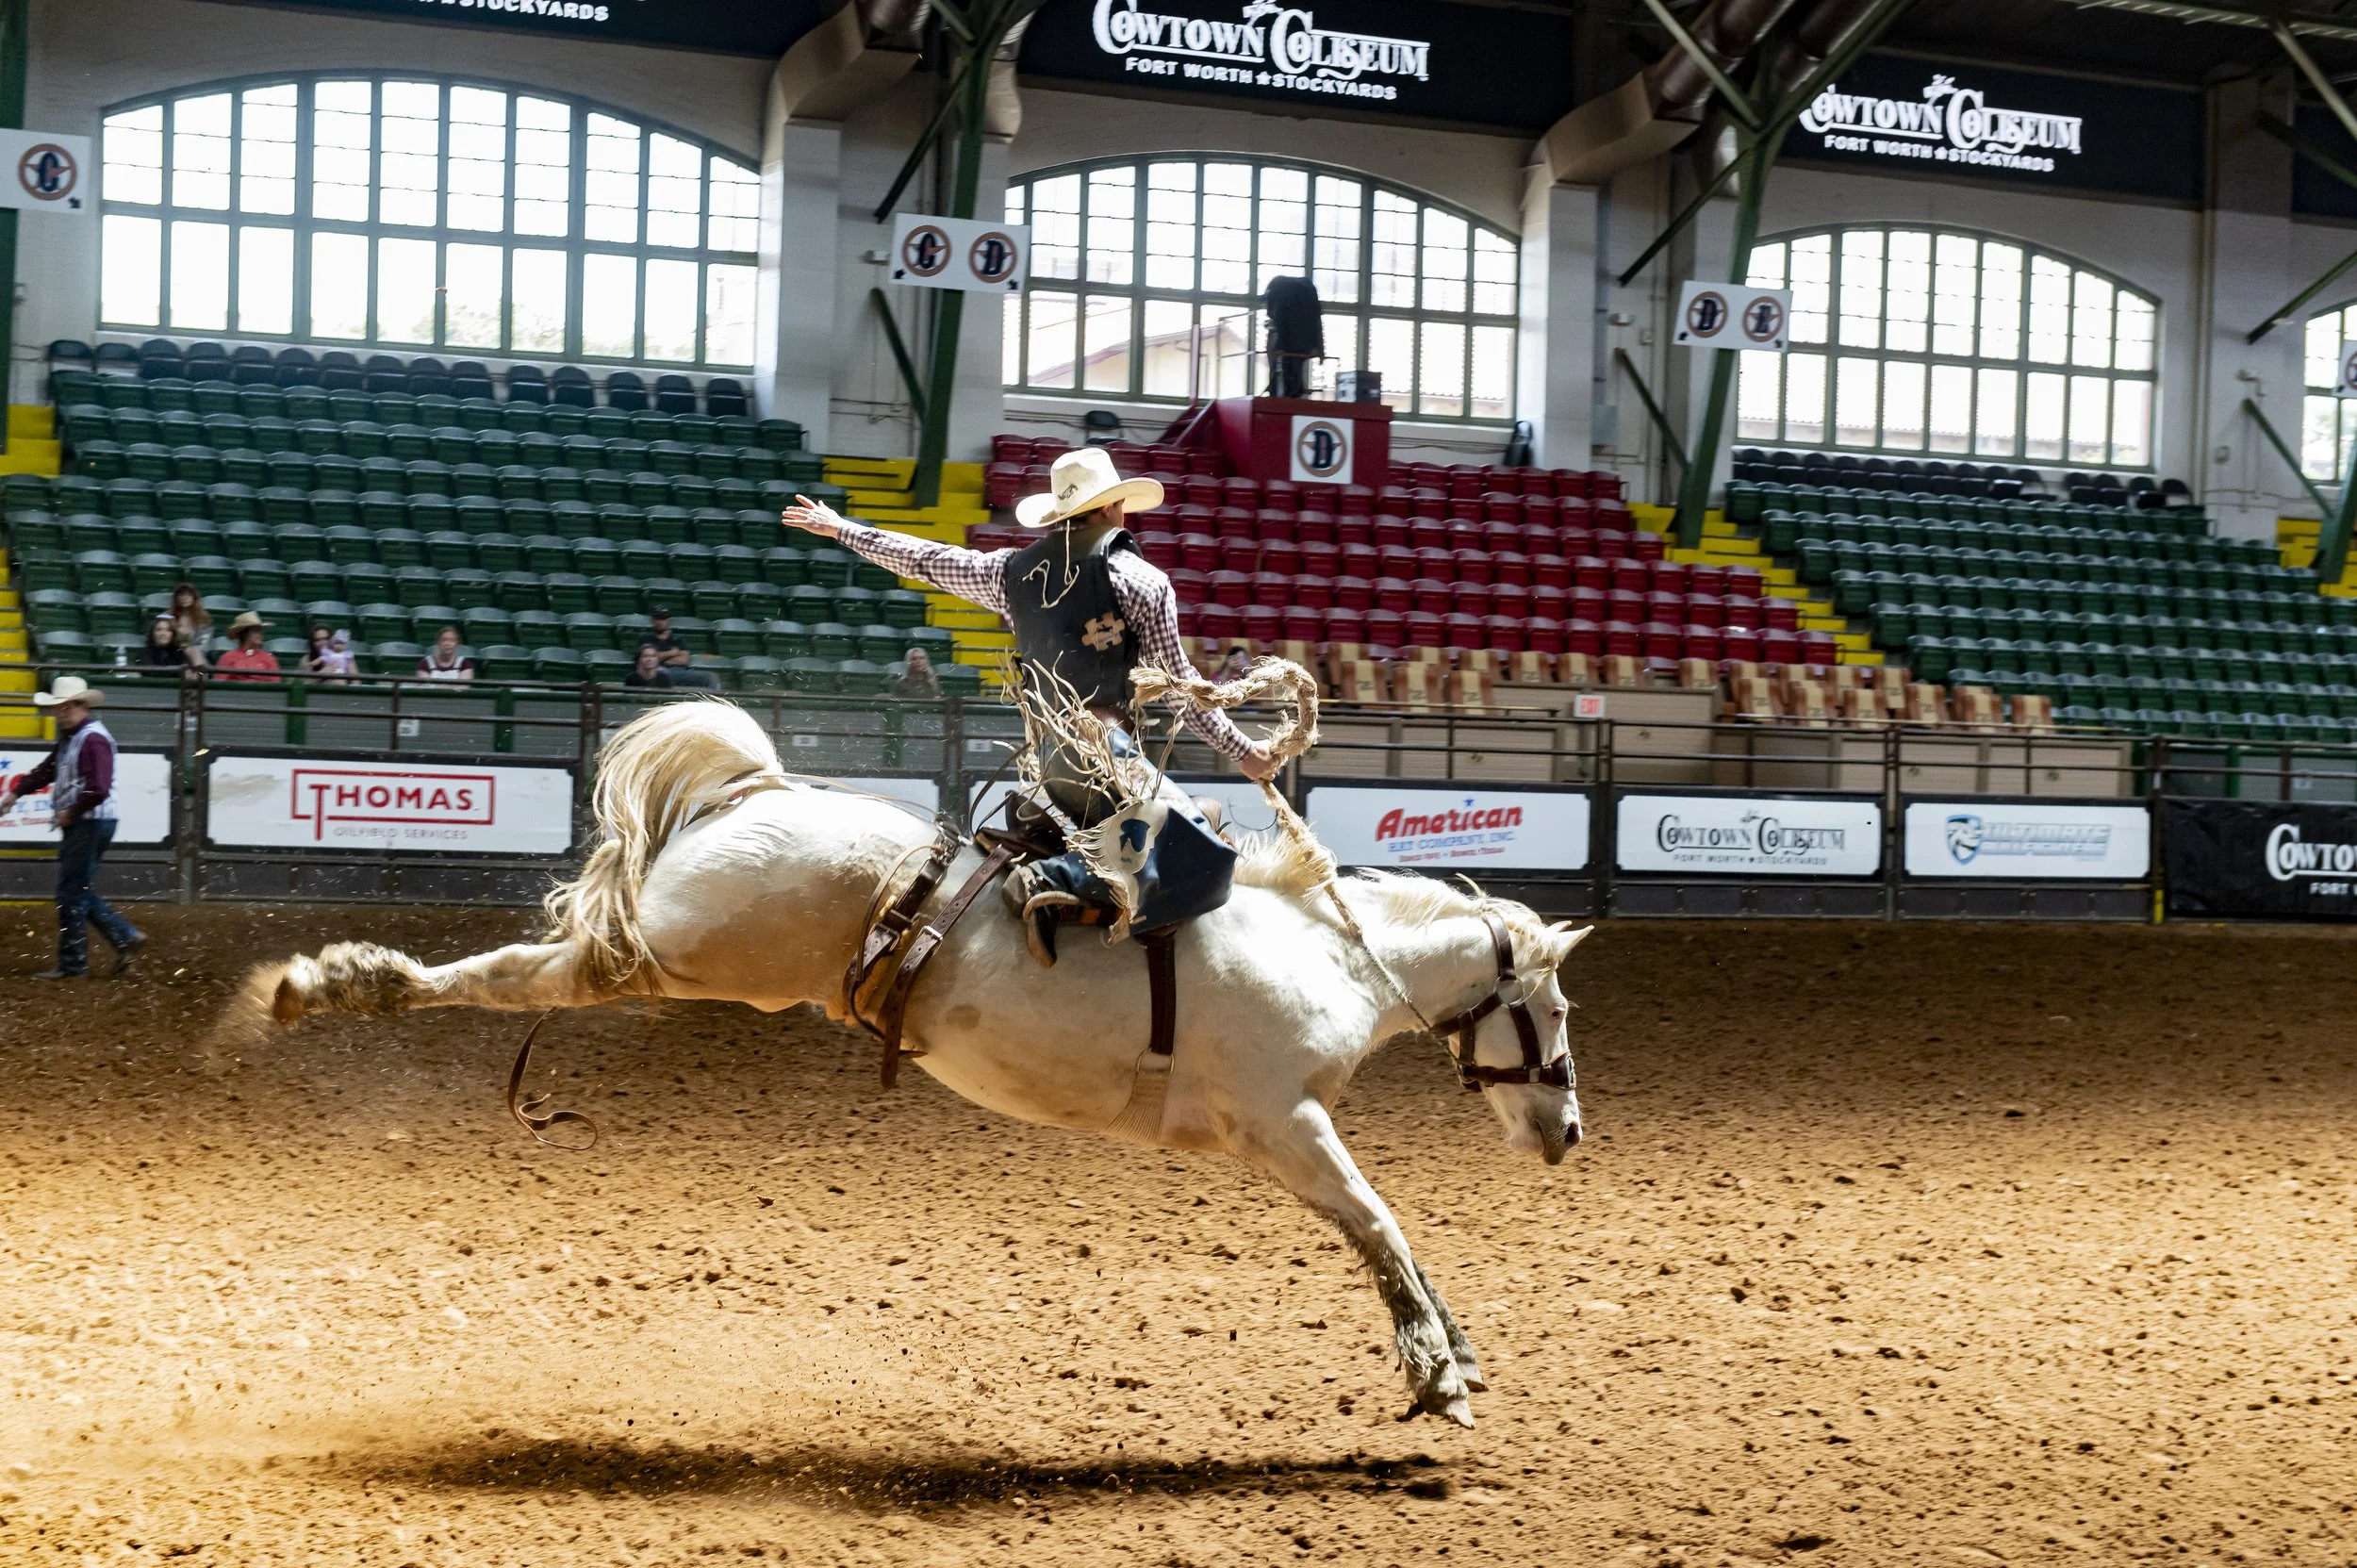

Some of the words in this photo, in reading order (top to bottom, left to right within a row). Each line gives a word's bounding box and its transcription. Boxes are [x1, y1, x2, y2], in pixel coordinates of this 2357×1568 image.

[1093, 0, 1265, 63] COWTOWN
[1270, 8, 1430, 81] COLISEUM
[1126, 57, 1178, 75] FORT
[1183, 63, 1254, 85] WORTH
[1272, 74, 1397, 100] STOCKYARDS
[1946, 89, 2082, 155] COLISEUM
[1824, 135, 1870, 152] FORT
[1872, 140, 1933, 158] WORTH
[1948, 149, 2054, 172] STOCKYARDS
[308, 784, 473, 841] THOMAS
[1376, 806, 1524, 841] American
[1657, 814, 1753, 852] COWTOWN
[404, 829, 468, 840] SERVICES
[2266, 823, 2357, 881] COWTO
